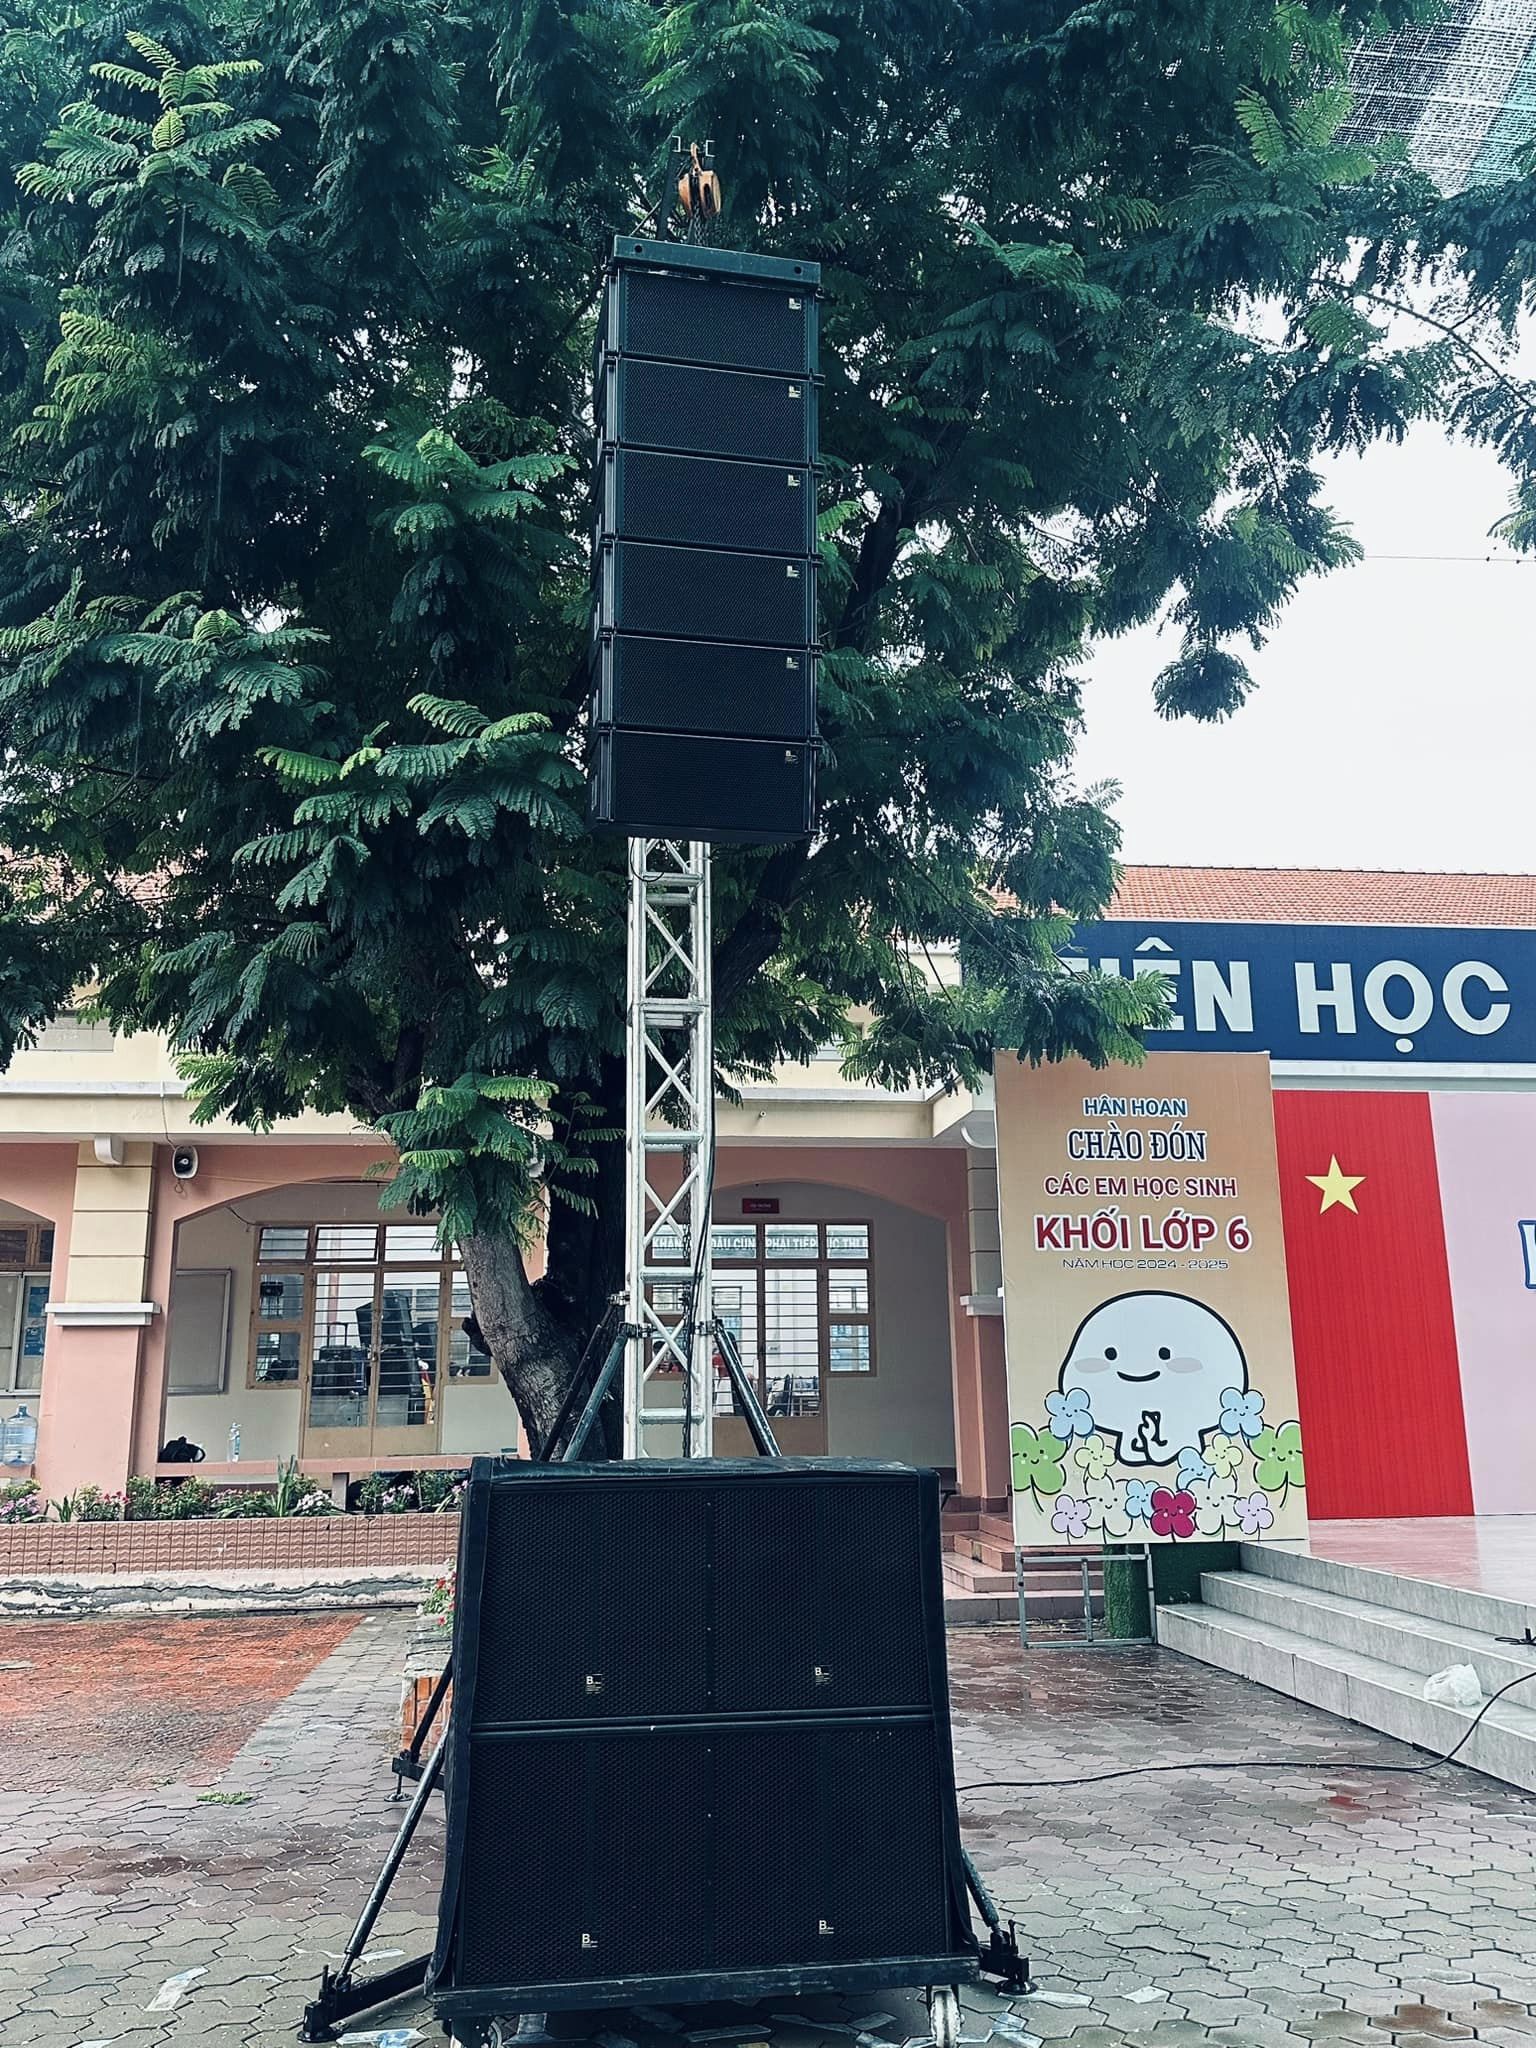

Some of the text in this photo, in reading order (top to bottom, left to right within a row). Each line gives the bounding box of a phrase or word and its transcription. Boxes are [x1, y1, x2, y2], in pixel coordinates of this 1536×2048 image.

[1295, 960, 1510, 1053] HỌC
[1084, 1095, 1187, 1116] HÂN HOAN
[1068, 1121, 1206, 1160] CHÀO ĐÓN
[1045, 1173, 1237, 1200] CÁC EM HỌC SINH
[1036, 1207, 1250, 1250] KHỐI LỚP 6
[1063, 1257, 1099, 1269] NĂM
[1137, 1259, 1177, 1269] 2024
[1188, 1259, 1229, 1270] 2025
